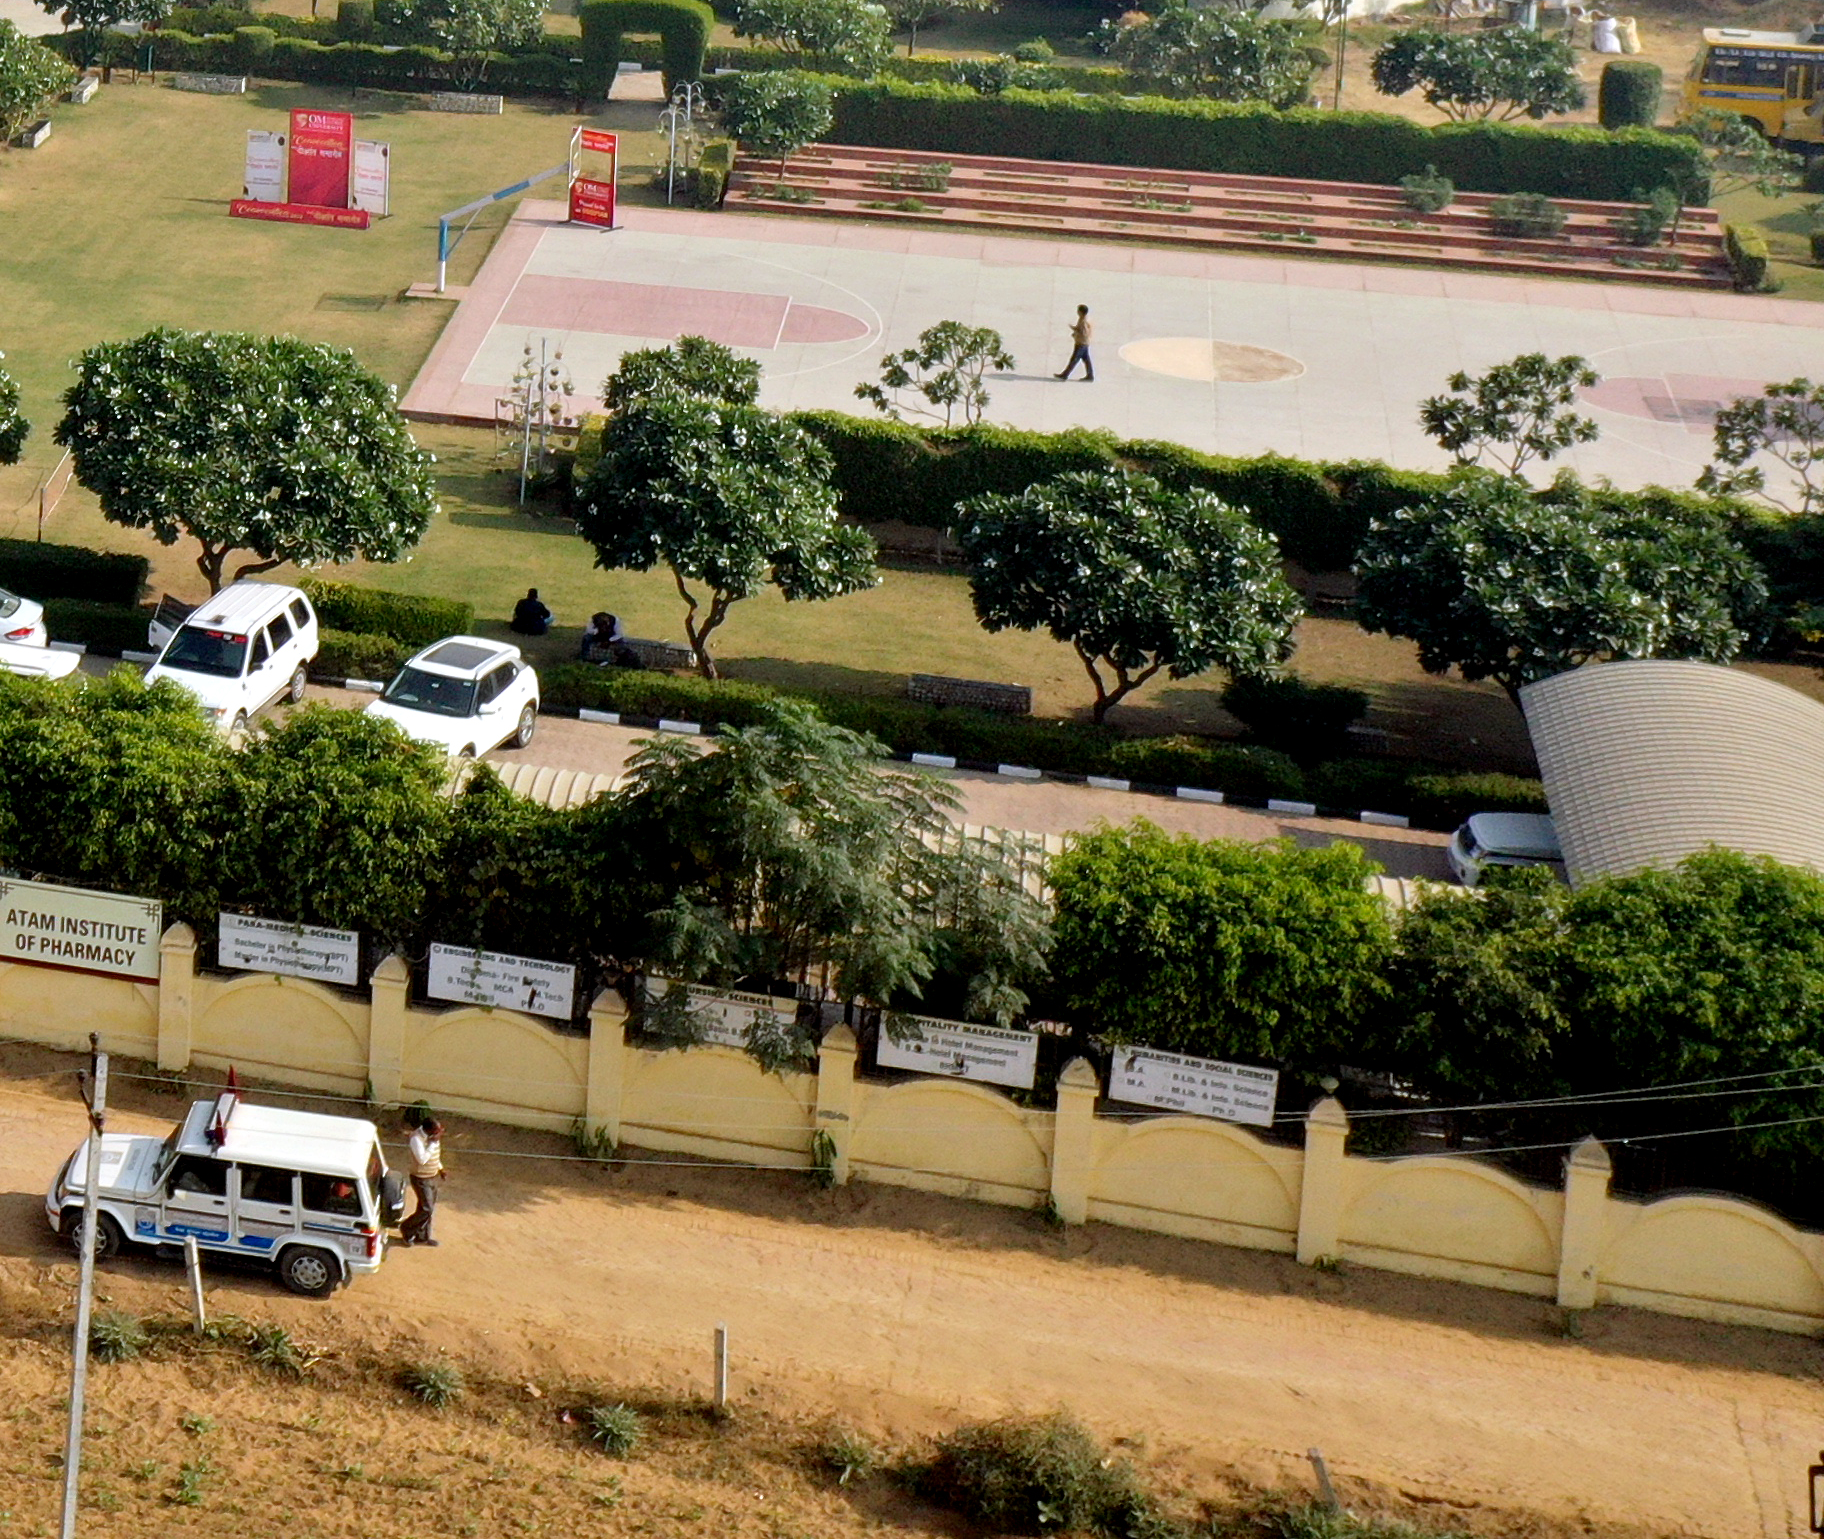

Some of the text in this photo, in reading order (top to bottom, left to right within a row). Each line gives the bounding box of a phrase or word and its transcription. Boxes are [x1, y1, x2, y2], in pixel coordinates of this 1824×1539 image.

[5, 908, 147, 945] ATAM INSTITUTE
[310, 928, 352, 942] SCIENCES
[15, 933, 136, 967] OF PHARMACY
[499, 956, 517, 966] AND
[519, 959, 571, 974] TECHNOLOGY
[962, 1026, 1033, 1043] MANAGEMENT
[1205, 1063, 1233, 1074] SOCIAL
[1236, 1068, 1274, 1081] SCIENCES
